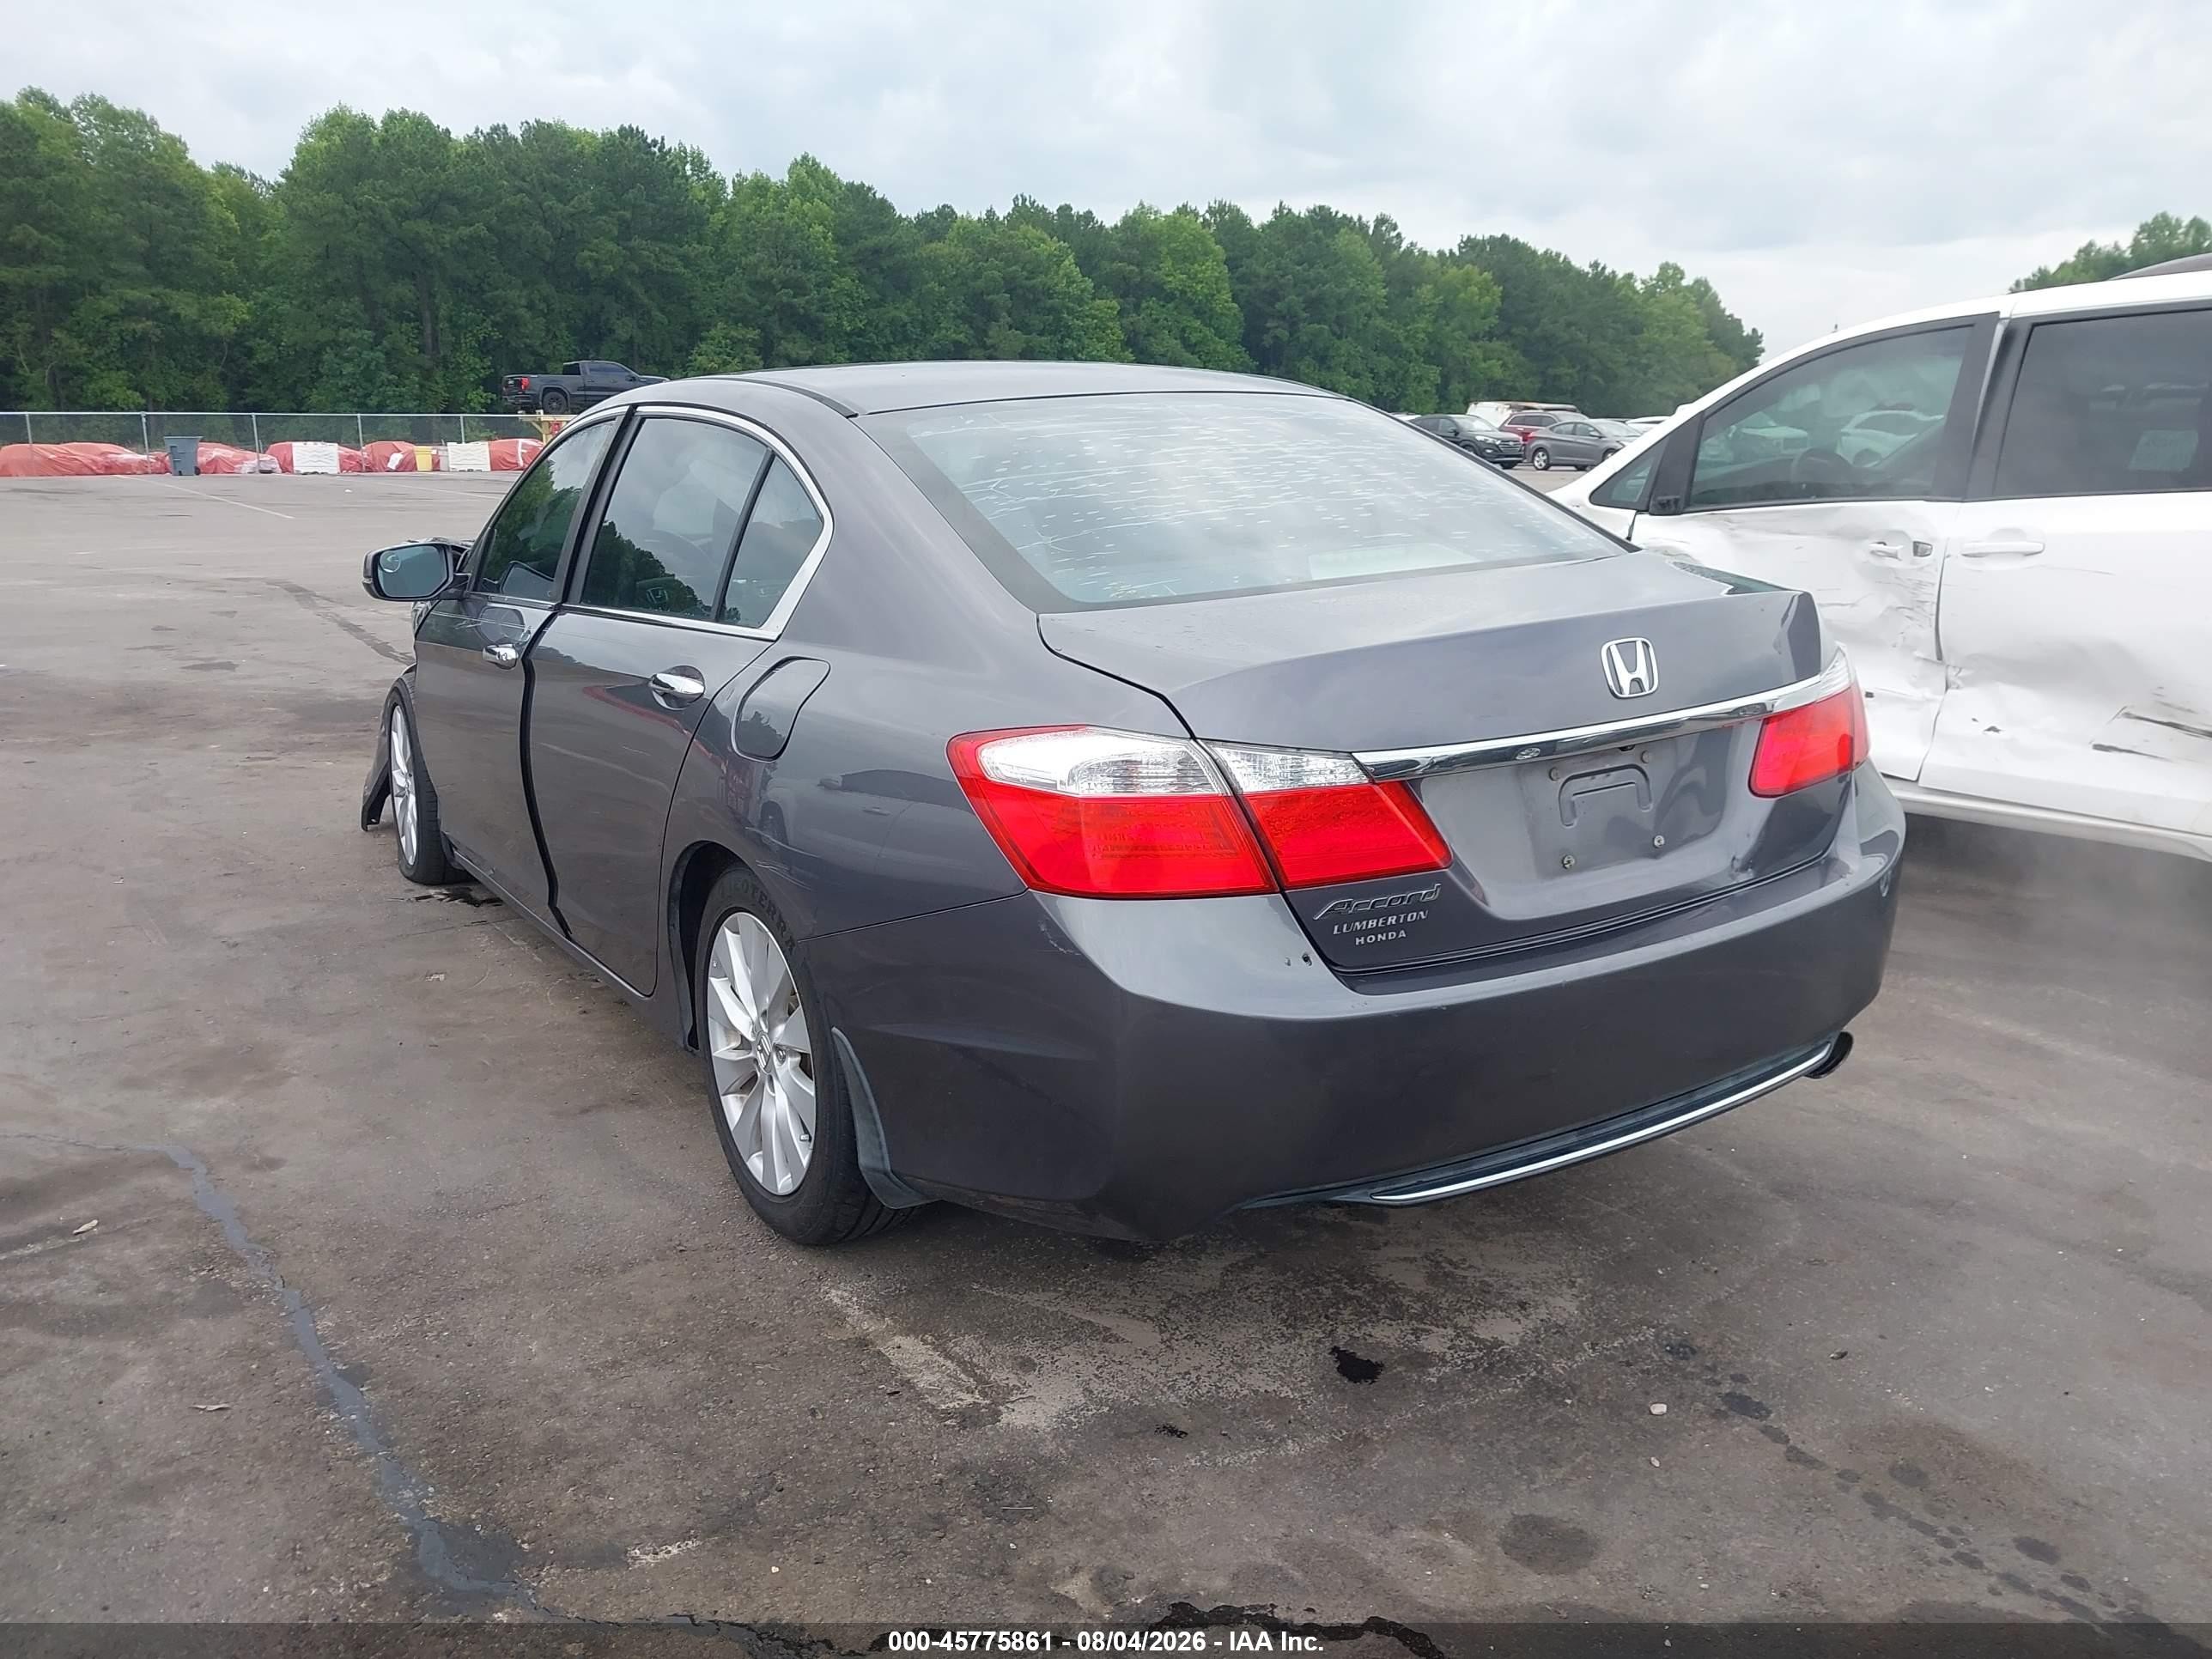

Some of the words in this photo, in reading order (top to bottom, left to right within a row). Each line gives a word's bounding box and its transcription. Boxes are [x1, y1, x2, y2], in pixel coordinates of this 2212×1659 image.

[1313, 884, 1442, 921] Accord
[1333, 909, 1429, 935] LUMBERTON
[1355, 929, 1407, 945] HONDA
